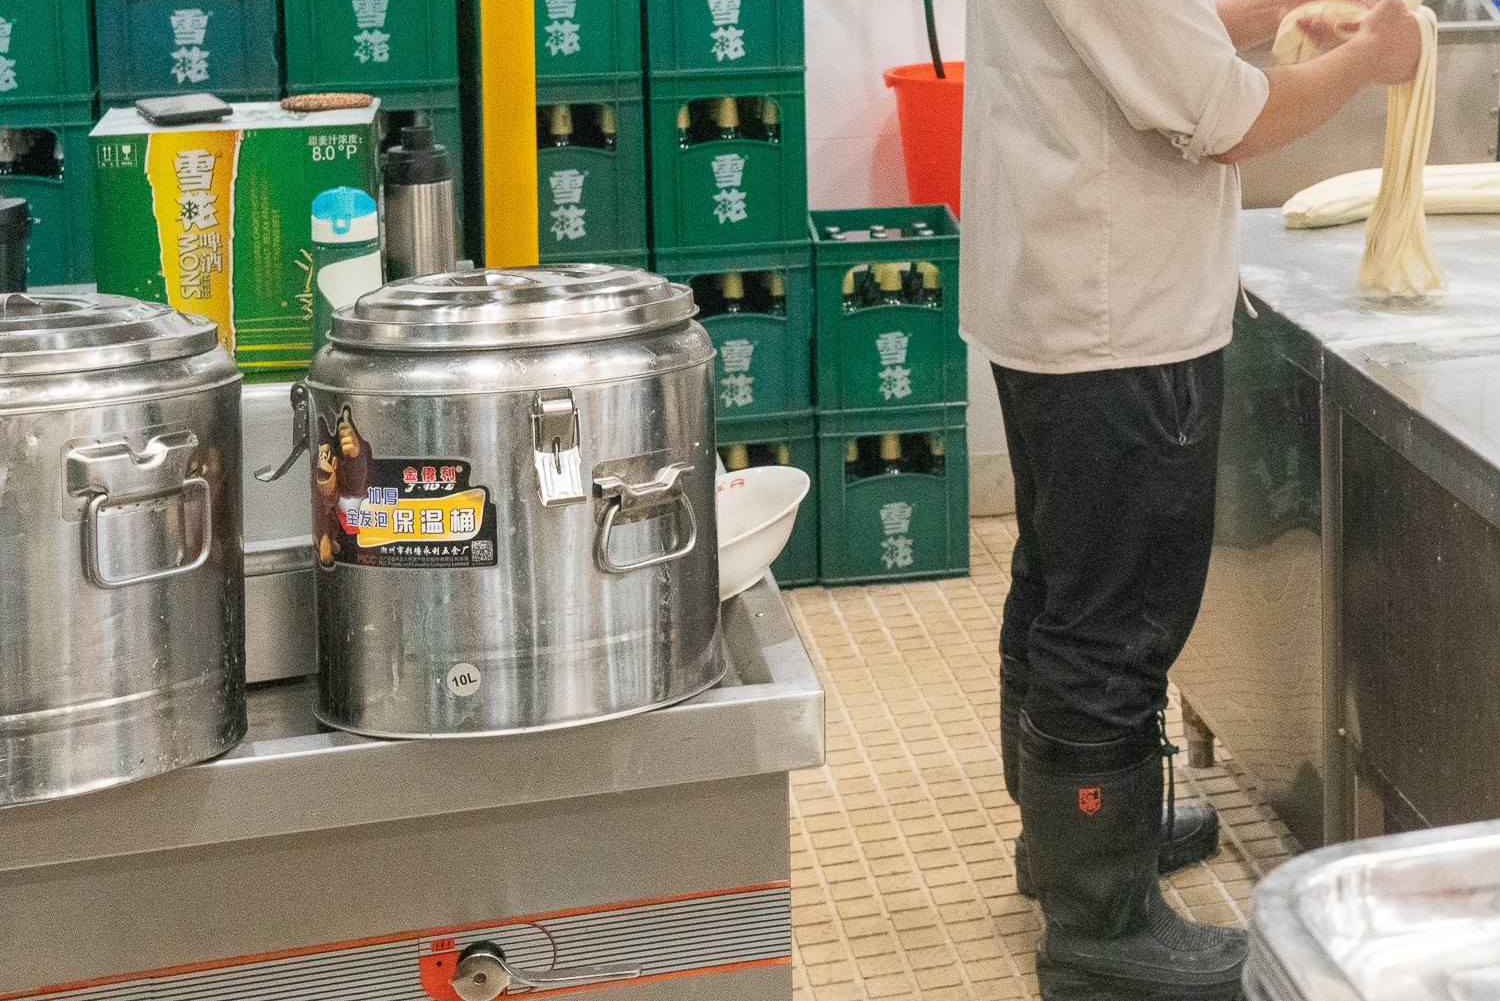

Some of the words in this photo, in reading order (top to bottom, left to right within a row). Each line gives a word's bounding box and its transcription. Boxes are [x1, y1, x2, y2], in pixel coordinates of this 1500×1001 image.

[170, 8, 209, 84] 雪花
[172, 148, 219, 233] 雪花
[549, 168, 586, 240] 雪花
[712, 153, 747, 224] 雪花
[177, 233, 201, 300] SNOW
[200, 232, 223, 274] 啤酒
[720, 338, 753, 408] 雪花
[877, 331, 911, 400] 雪花
[346, 508, 388, 528] 全发泡
[391, 508, 476, 535] 保温桶
[368, 486, 399, 506] 加厚
[880, 501, 913, 569] 雪花
[452, 673, 477, 687] 10L
